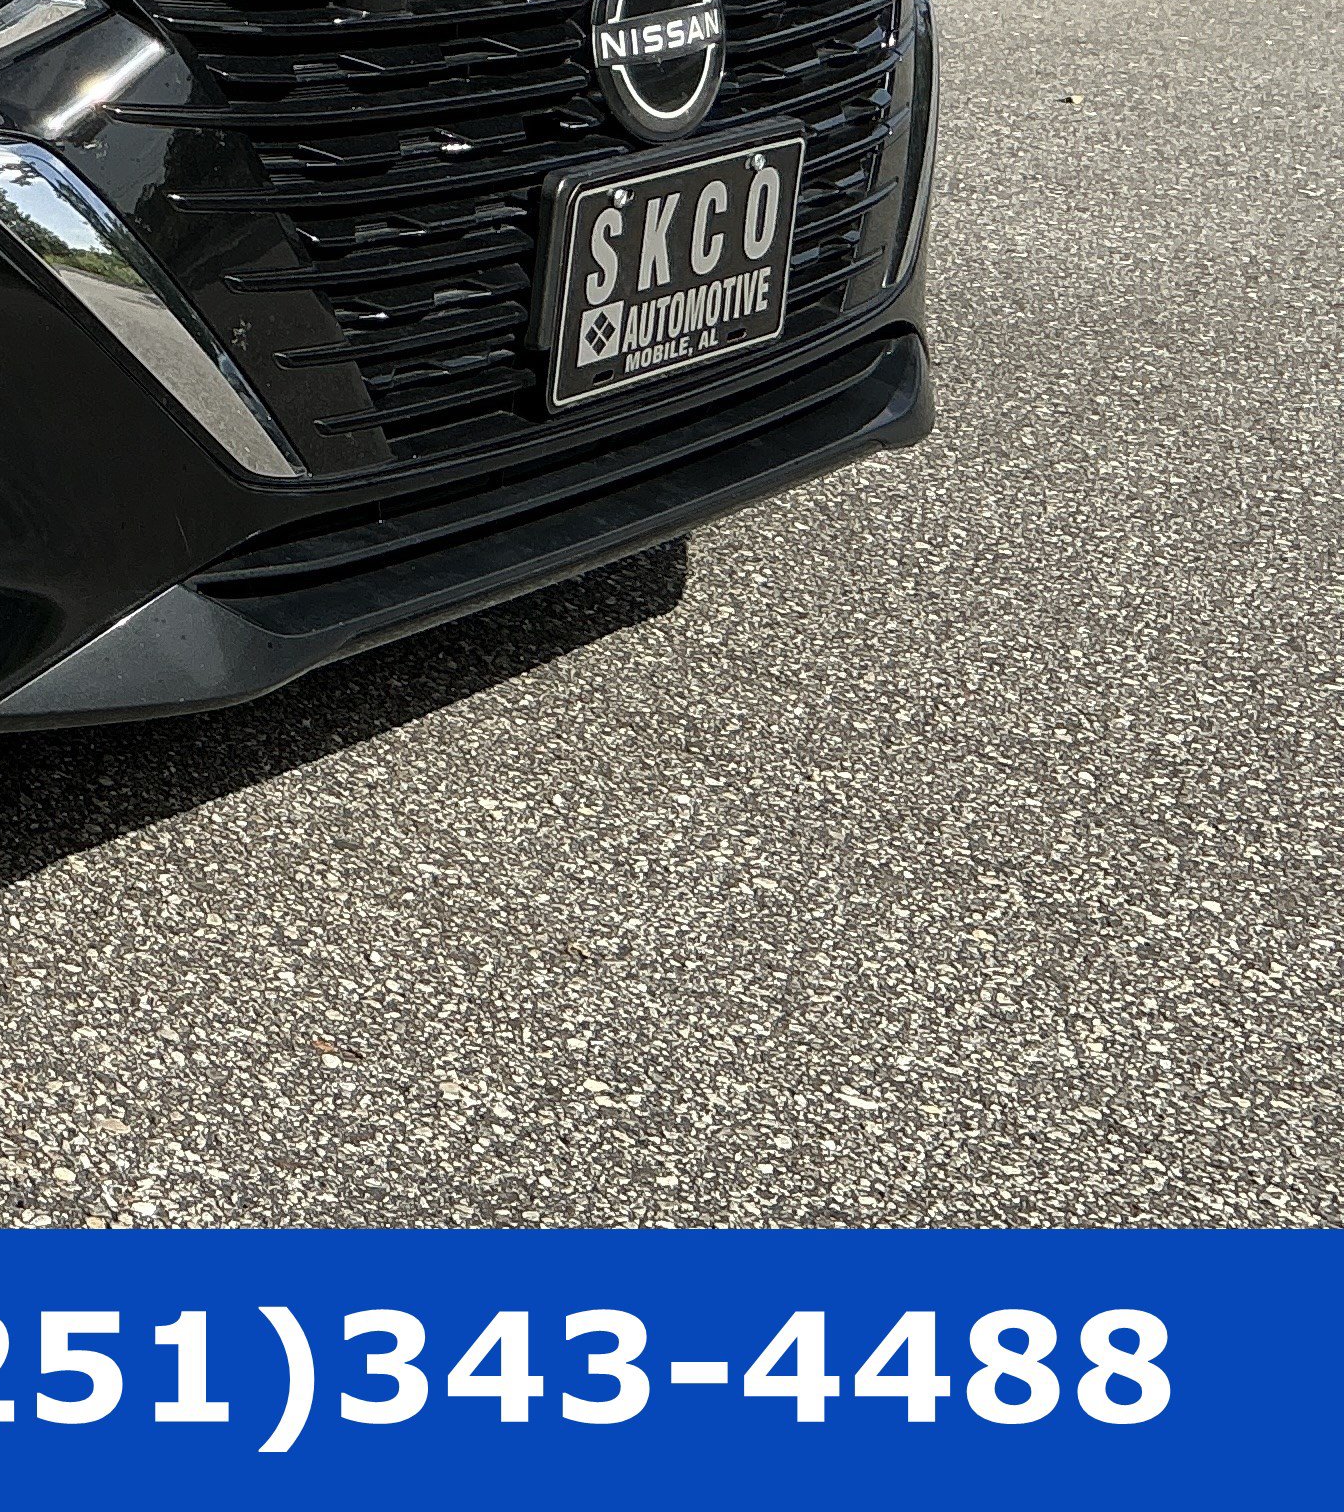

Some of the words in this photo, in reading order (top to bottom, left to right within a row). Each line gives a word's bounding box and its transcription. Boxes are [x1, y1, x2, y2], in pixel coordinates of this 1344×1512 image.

[599, 8, 721, 60] NISSAN
[585, 166, 781, 306] SKCO
[620, 266, 772, 354] AUTOMOTIVE
[624, 335, 694, 374] MOBILE,
[698, 328, 720, 352] AL
